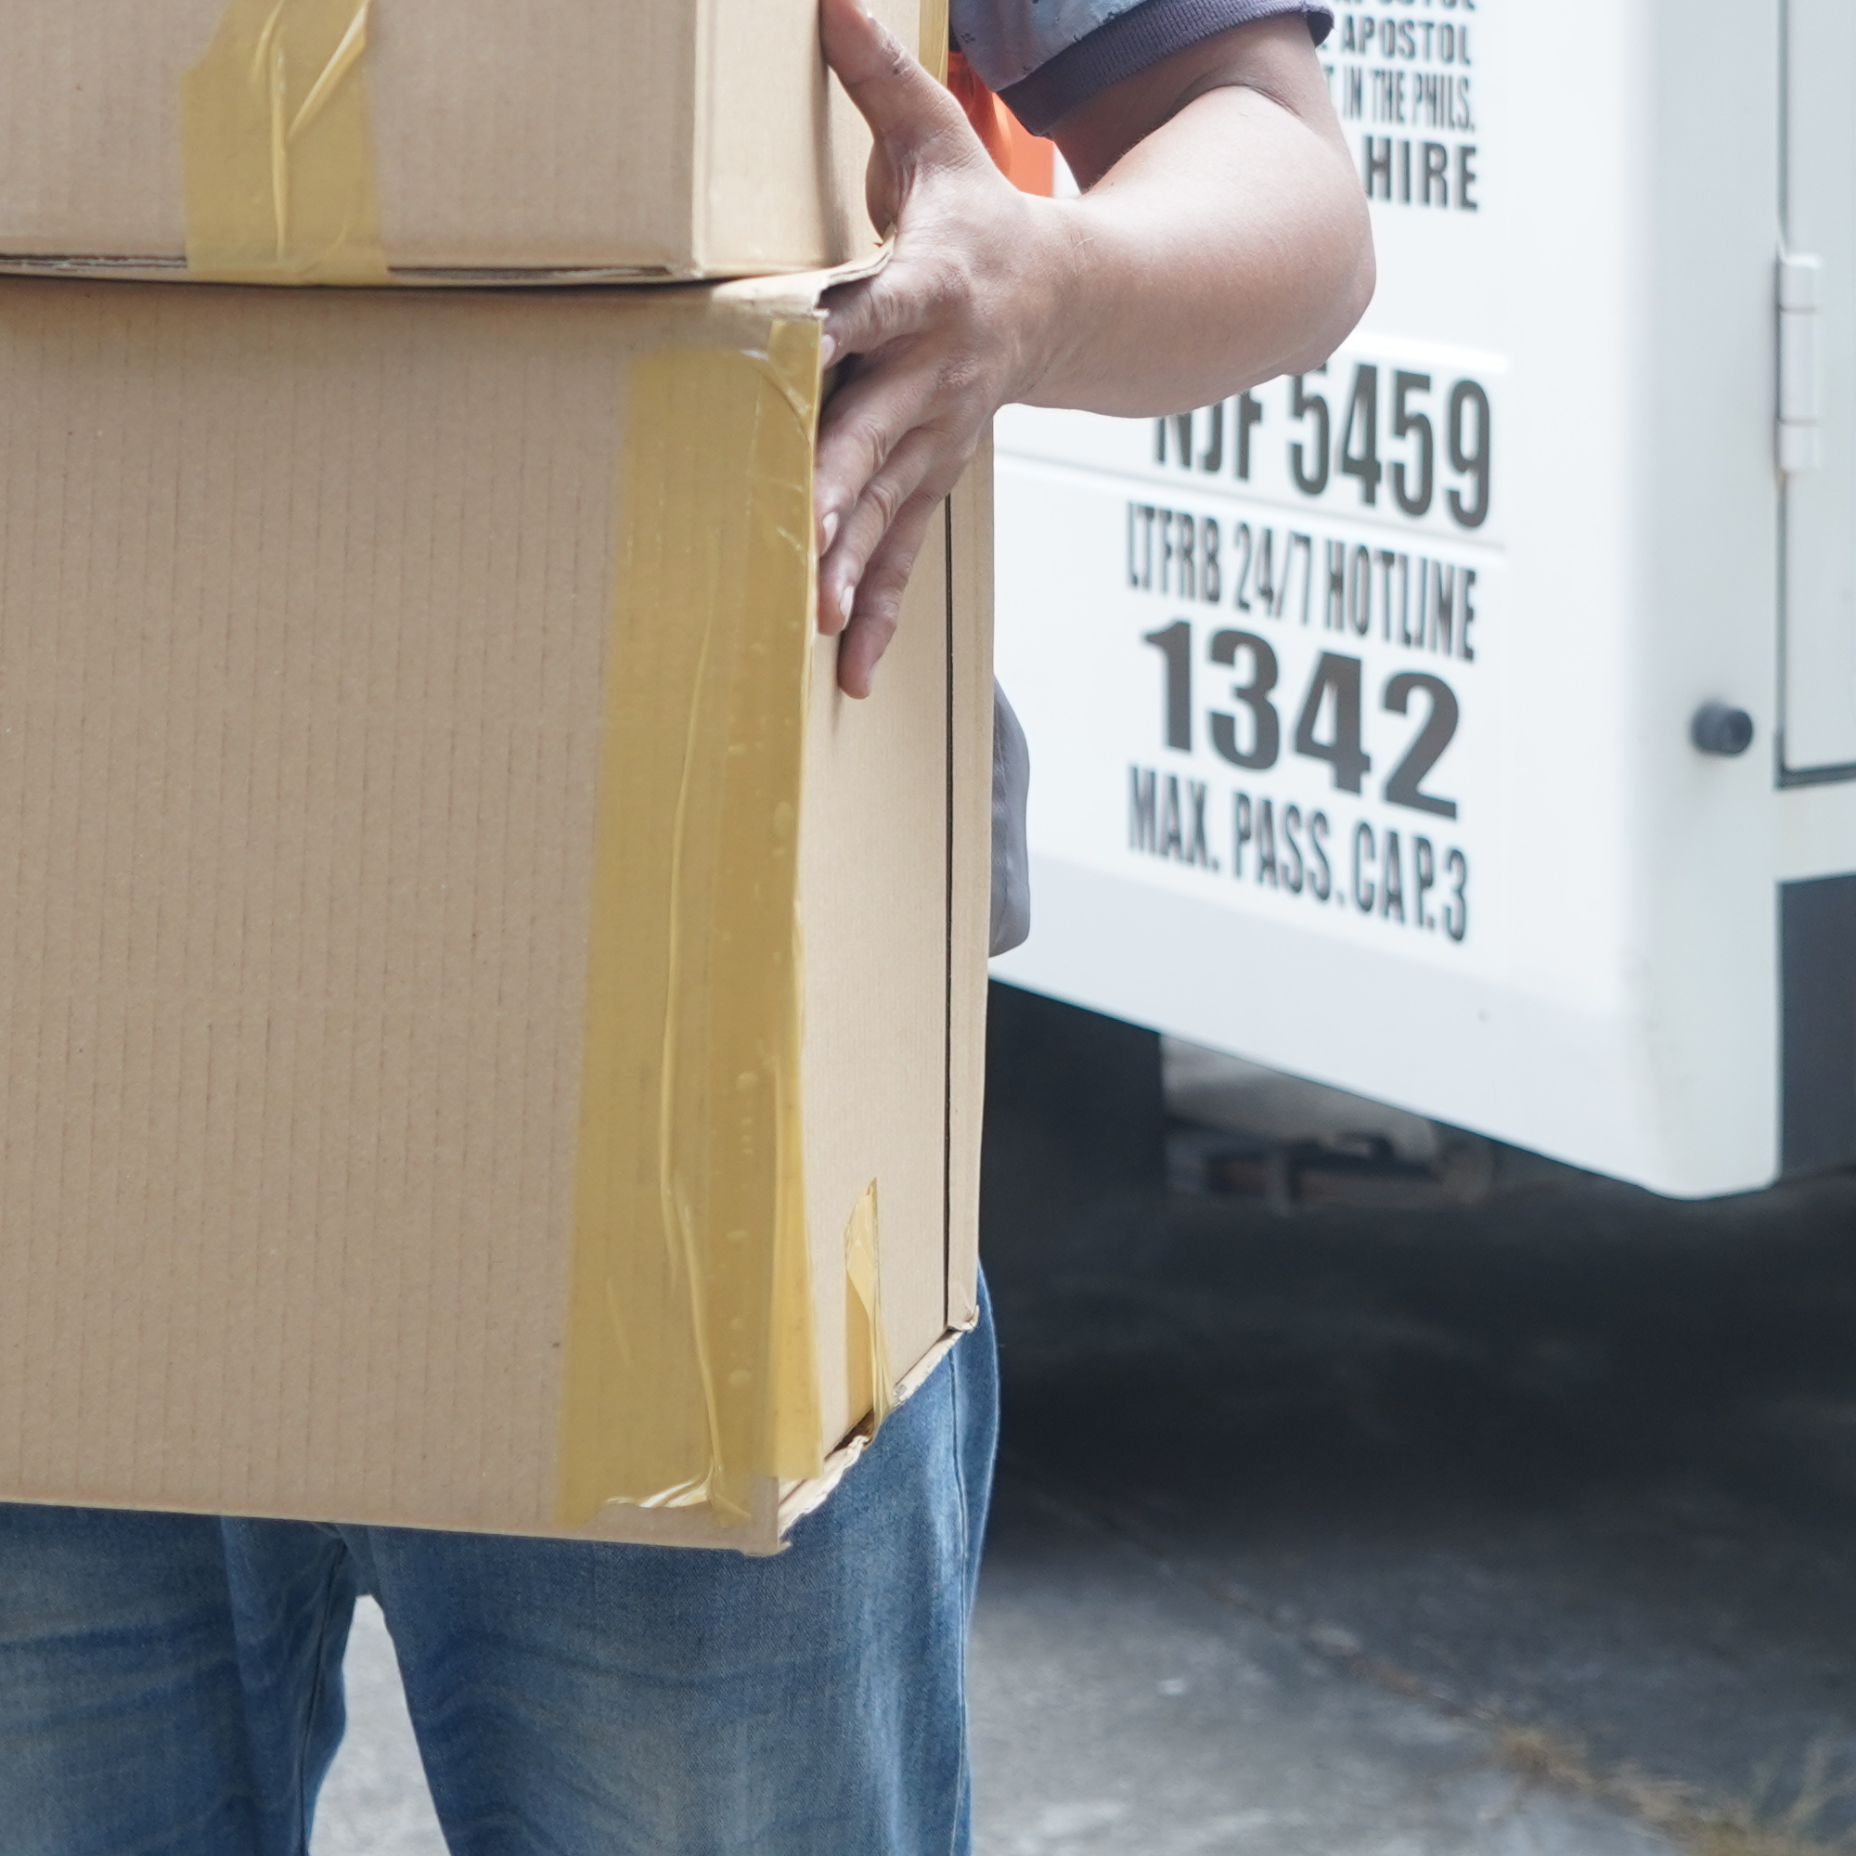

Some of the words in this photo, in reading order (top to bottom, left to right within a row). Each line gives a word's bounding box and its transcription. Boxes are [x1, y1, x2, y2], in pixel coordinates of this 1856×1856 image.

[1341, 15, 1471, 67] APOSTOL
[1343, 64, 1363, 122] IN
[1370, 67, 1405, 125] THE
[1363, 134, 1479, 212] HIRE
[1287, 359, 1492, 529] 5459
[1127, 501, 1221, 605] LTFRB
[1236, 521, 1312, 627] 24/7
[1324, 537, 1477, 664] HOTLINE
[1141, 619, 1460, 821] 1342
[1128, 765, 1220, 873] MAX.
